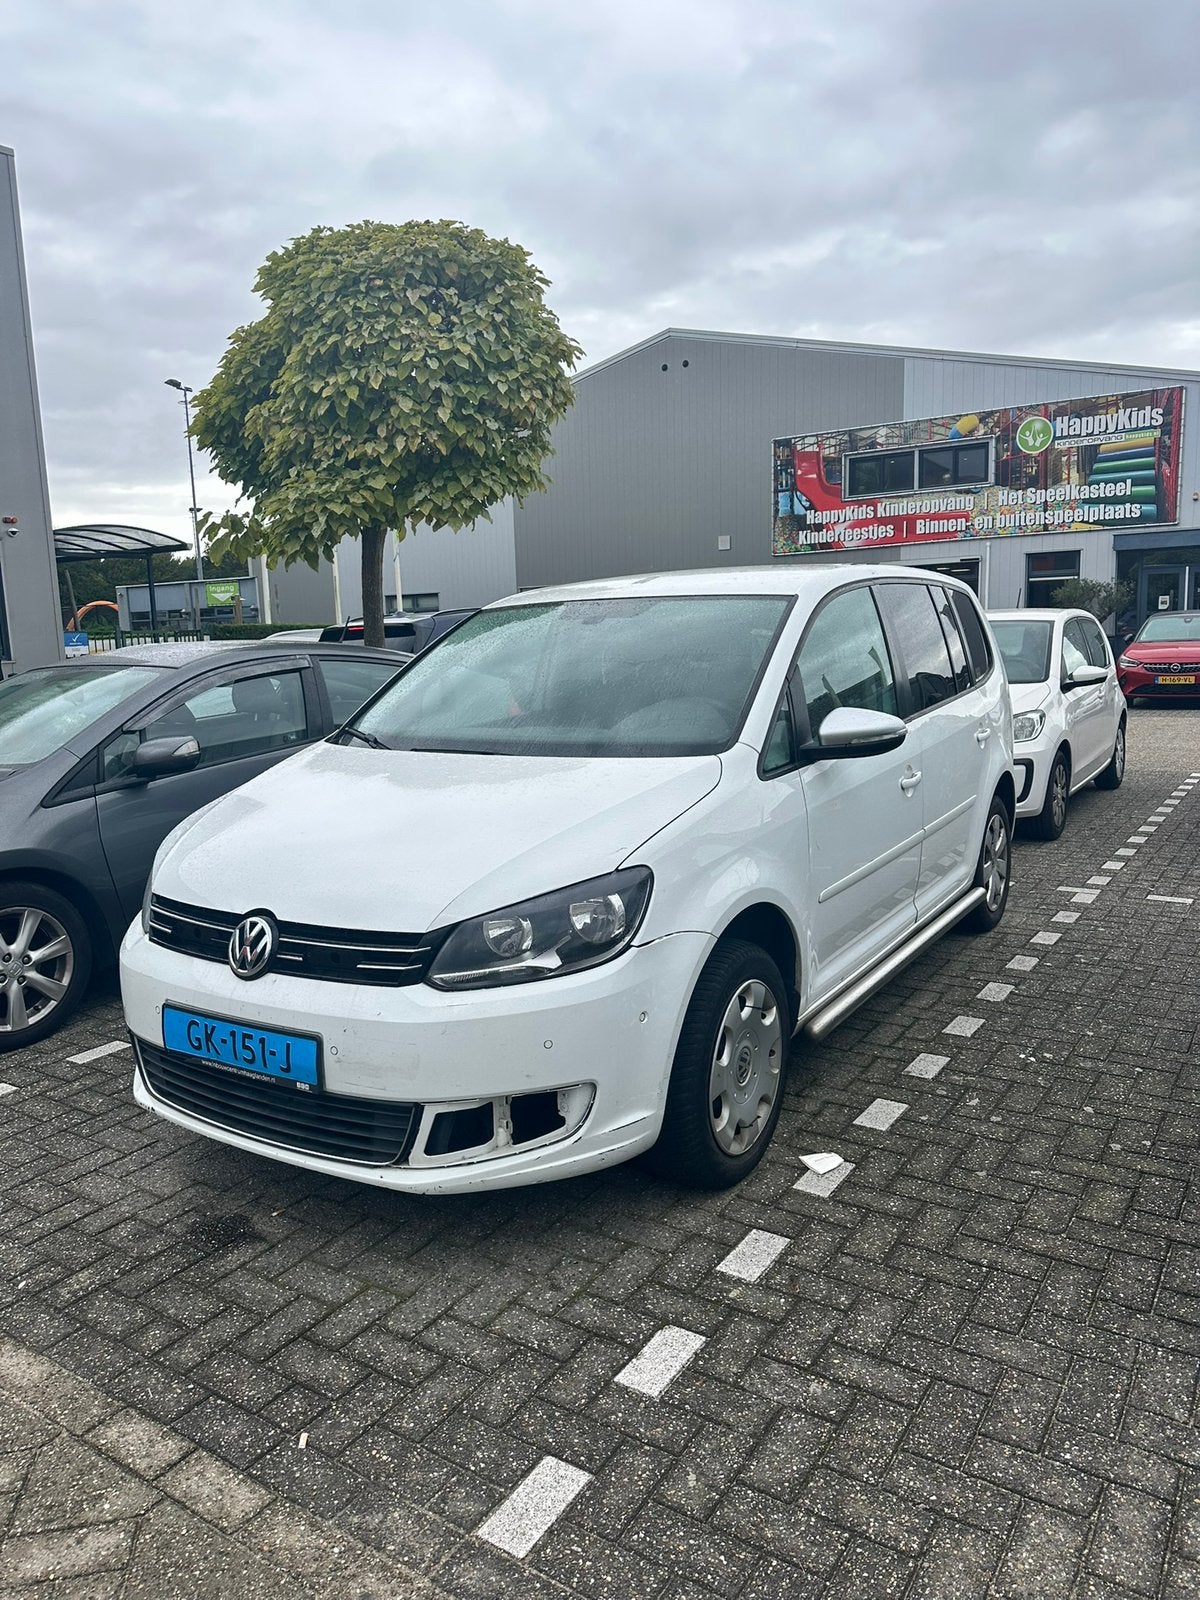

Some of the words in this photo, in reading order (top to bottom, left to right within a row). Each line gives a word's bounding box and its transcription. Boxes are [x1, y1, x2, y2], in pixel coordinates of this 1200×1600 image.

[1055, 406, 1164, 437] HappyKids
[806, 504, 875, 525] HappyKids
[877, 495, 974, 518] Kinderopvang
[998, 488, 1024, 507] Het
[1027, 479, 1132, 504] Speelkasteel
[799, 523, 895, 545] Kinderfeestjes
[916, 516, 971, 535] Binnen-
[974, 514, 994, 531] en
[998, 503, 1142, 529] buitenspeelplaats
[209, 584, 235, 593] Ingang
[187, 1019, 292, 1074] GK-151-J
